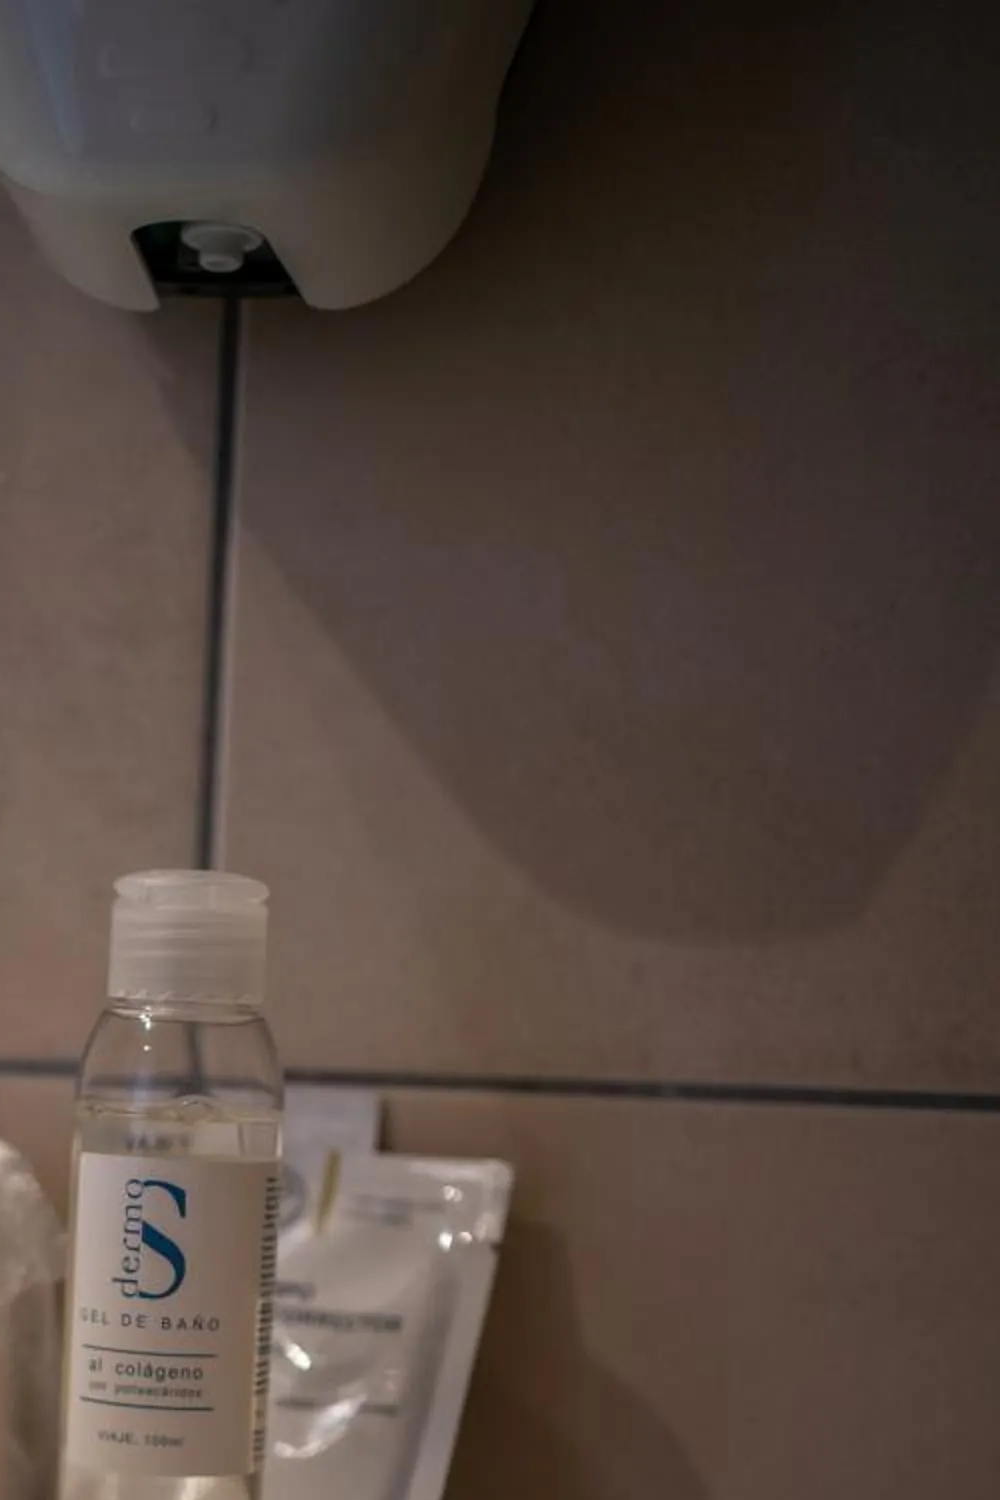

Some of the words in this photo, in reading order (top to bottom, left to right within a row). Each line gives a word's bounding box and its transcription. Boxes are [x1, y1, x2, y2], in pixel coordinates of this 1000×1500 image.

[111, 1178, 144, 1298] dermo
[120, 1312, 149, 1330] DE
[160, 1313, 221, 1332] BAÑO
[88, 1356, 103, 1372] al
[114, 1361, 204, 1383] colágeno
